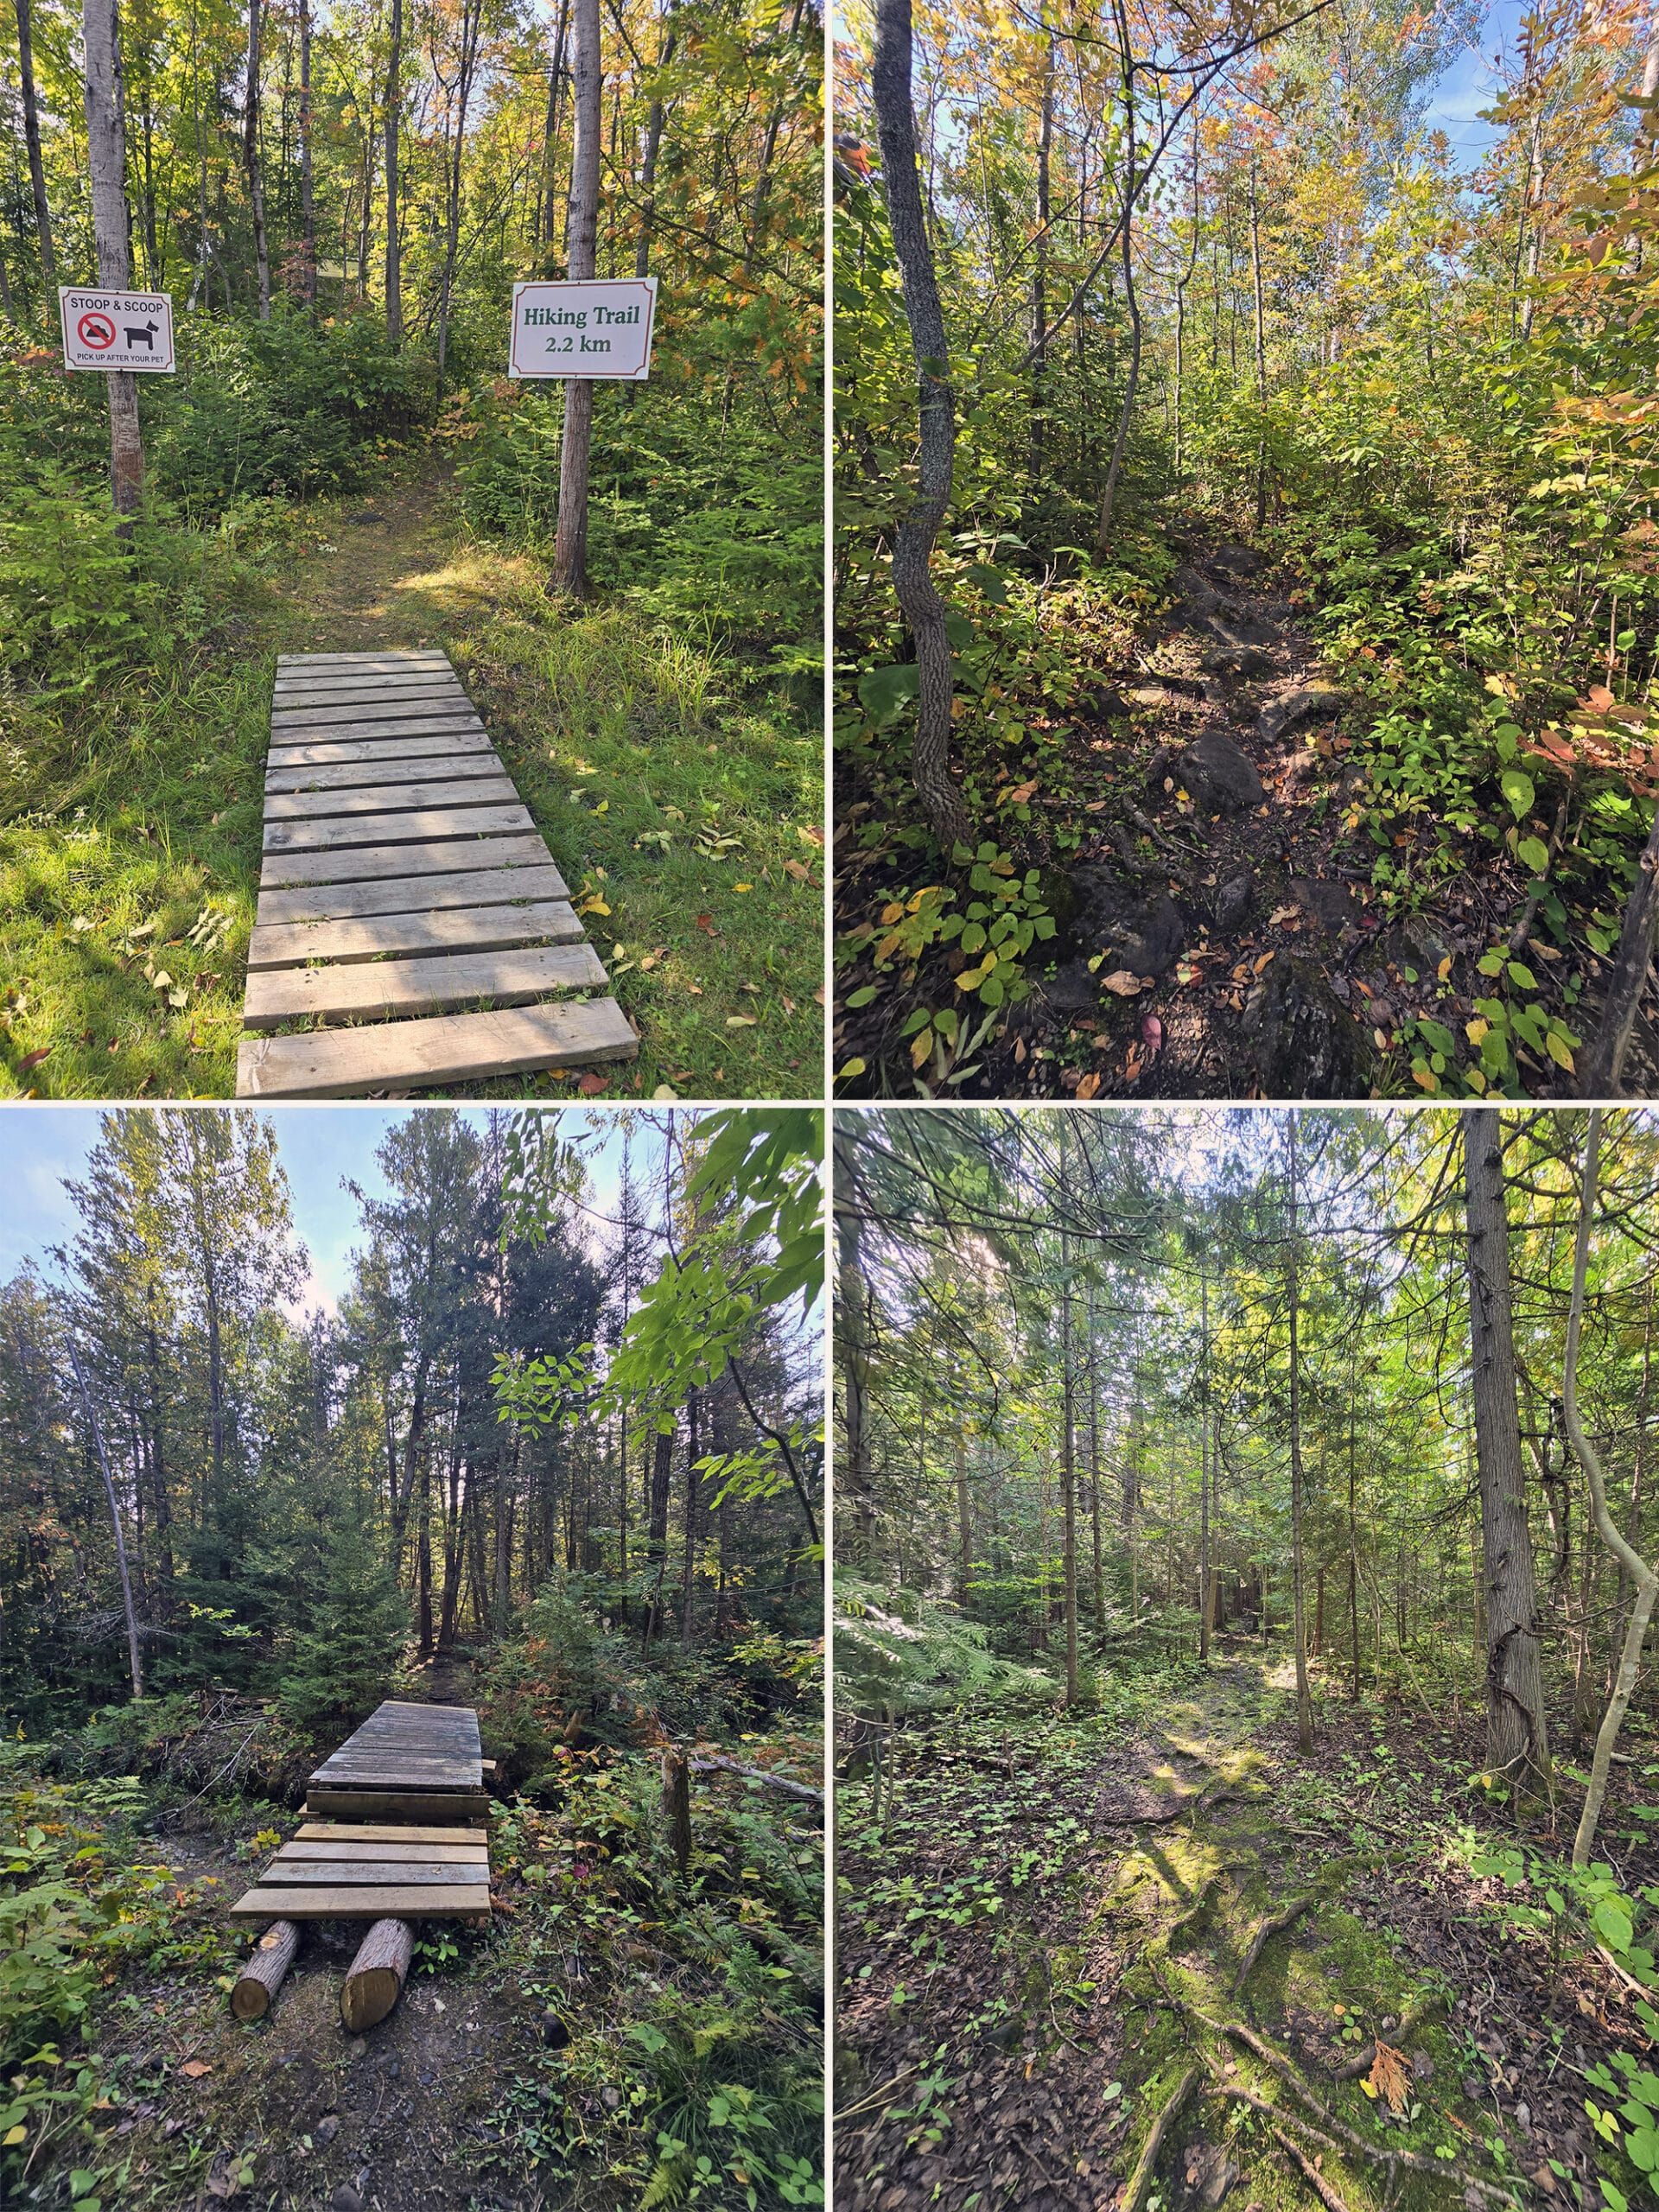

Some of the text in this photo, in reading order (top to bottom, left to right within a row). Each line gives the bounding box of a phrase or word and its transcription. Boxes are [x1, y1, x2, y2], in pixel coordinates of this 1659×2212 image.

[71, 297, 163, 313] STOOP & SCOOP
[524, 305, 640, 329] Hiking Trail
[545, 334, 611, 353] 2.2 km
